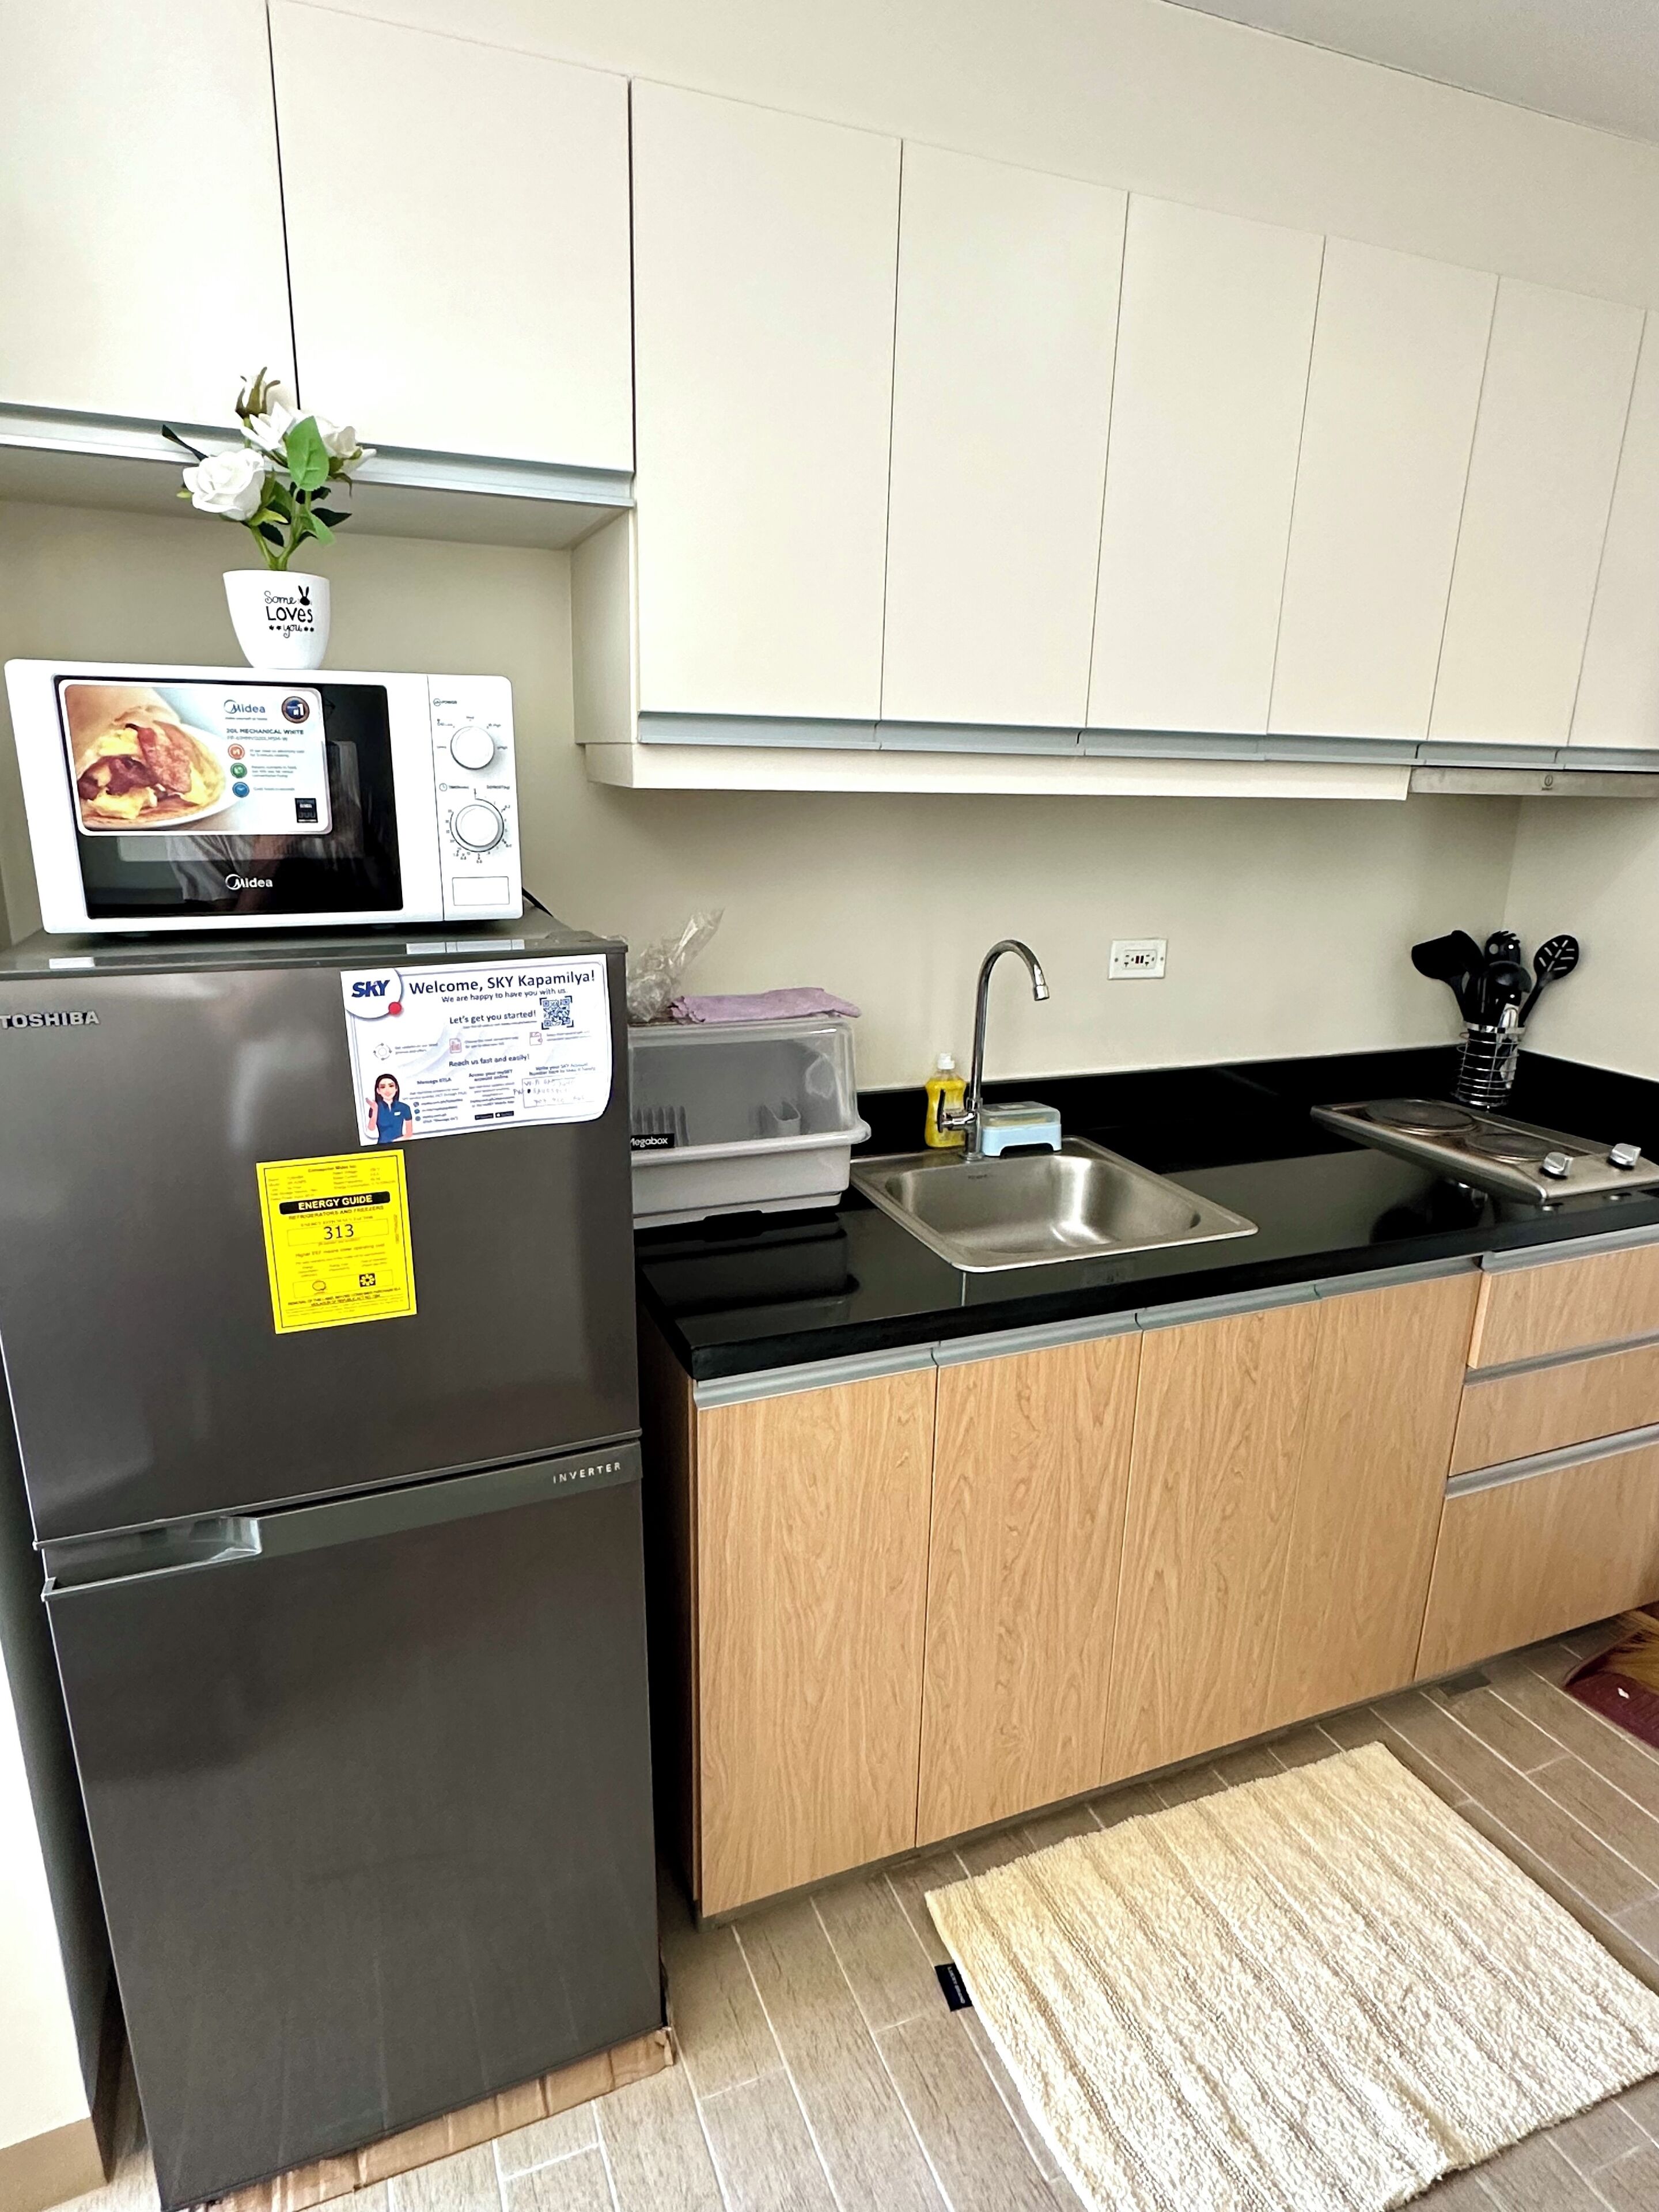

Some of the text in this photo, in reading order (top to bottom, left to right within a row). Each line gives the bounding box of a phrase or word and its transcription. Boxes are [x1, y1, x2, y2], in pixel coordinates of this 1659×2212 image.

[264, 590, 297, 604] Some
[283, 624, 302, 638] you
[224, 699, 266, 714] Midea
[225, 874, 273, 891] Midea
[351, 979, 390, 998] SKY
[409, 970, 594, 994] Welcome, SKY Kapamilya!
[0, 1010, 100, 1029] TOSHIBA
[449, 1010, 536, 1024] Let's get you started!
[449, 1059, 469, 1067] Reach
[298, 1194, 373, 1210] ENERGY GUIDE
[288, 1210, 339, 1220] REFRIGERATORS
[324, 1224, 354, 1240] 313
[553, 1462, 620, 1484] INVERTER
